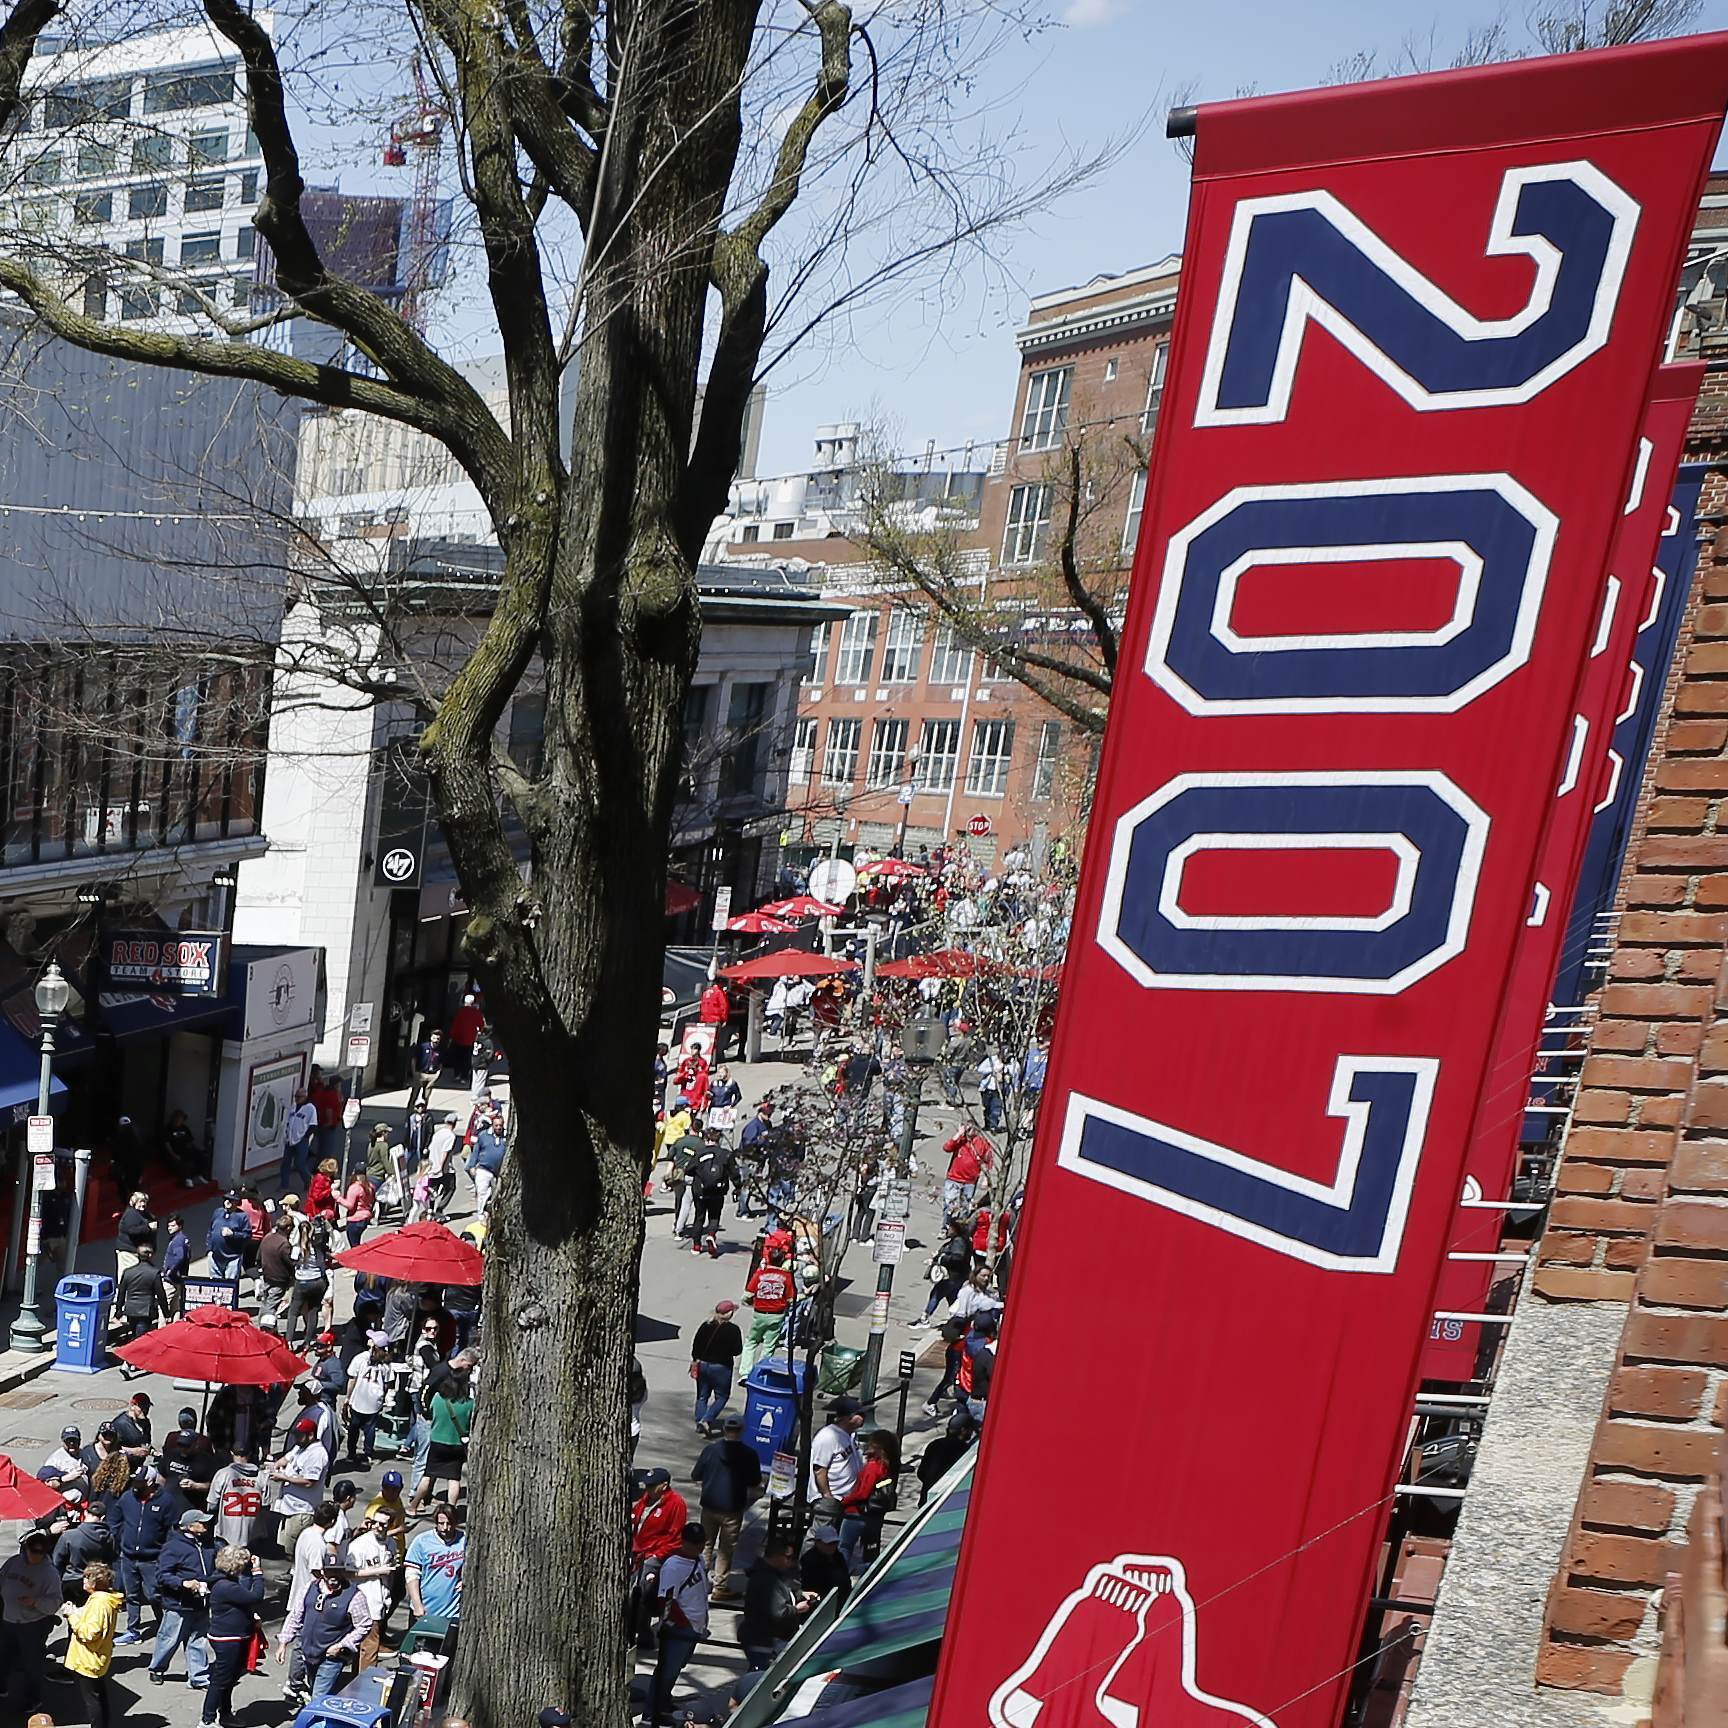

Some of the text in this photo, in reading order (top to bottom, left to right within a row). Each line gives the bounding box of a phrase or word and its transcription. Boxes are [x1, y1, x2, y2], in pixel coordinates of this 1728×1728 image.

[1058, 160, 1642, 1275] 2007
[968, 821, 990, 831] STOP
[111, 940, 212, 967] RED SOX
[114, 966, 205, 978] TEAM STORE
[223, 1492, 261, 1517] 26
